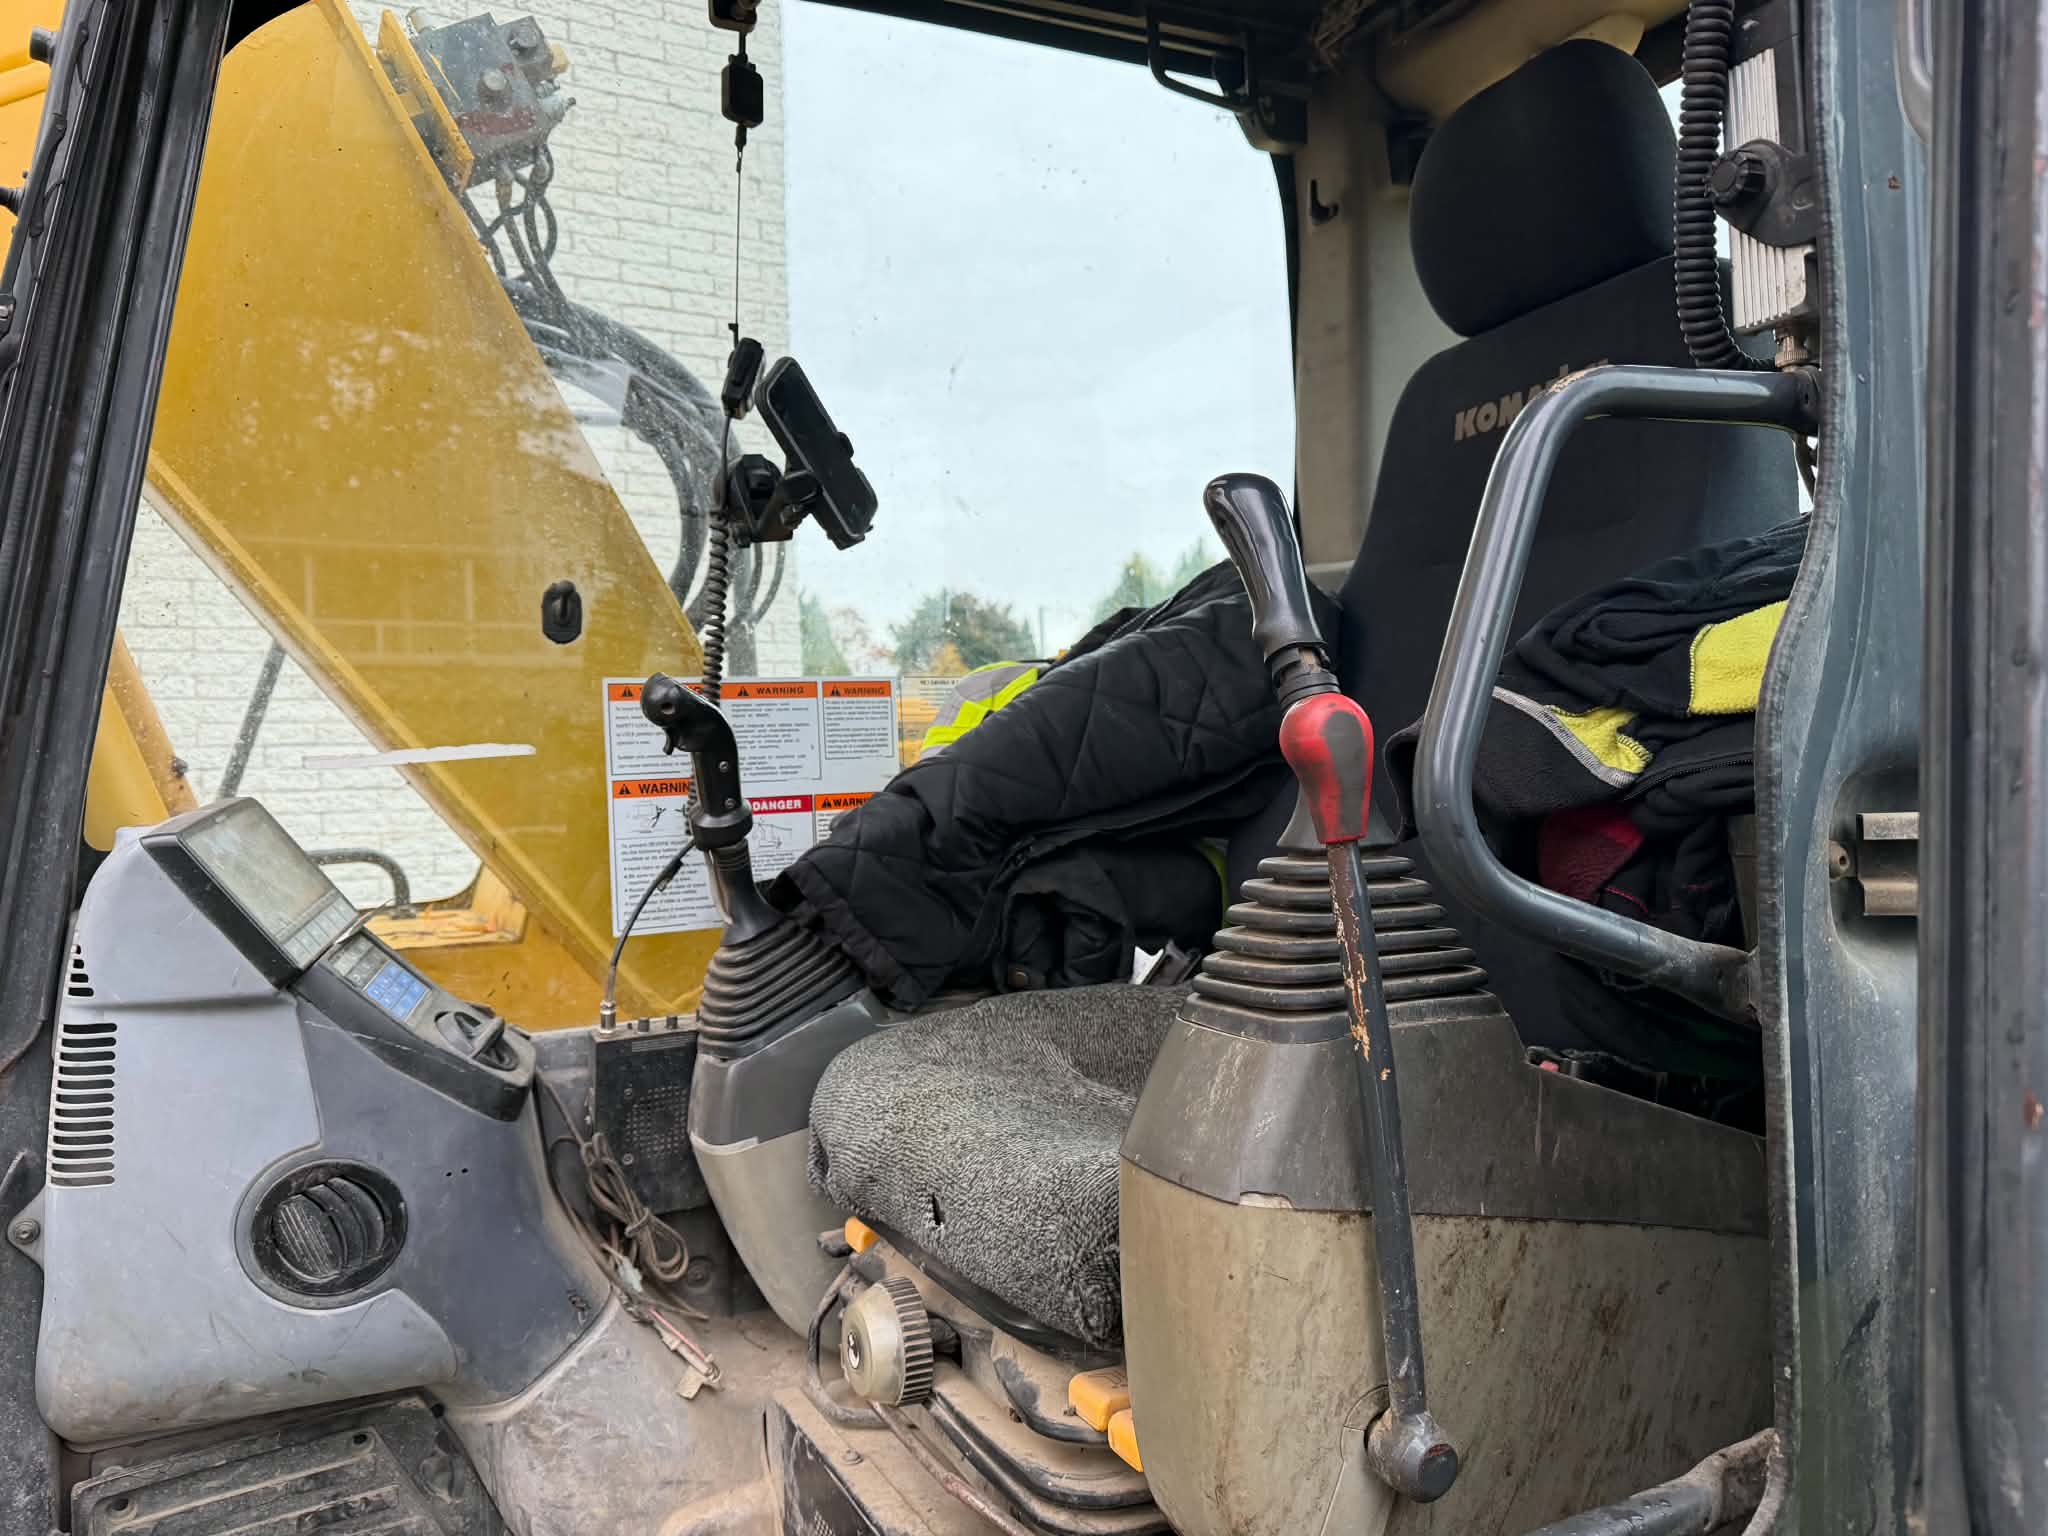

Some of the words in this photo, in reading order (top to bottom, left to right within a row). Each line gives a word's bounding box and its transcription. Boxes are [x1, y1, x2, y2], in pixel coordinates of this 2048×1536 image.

[756, 687, 804, 695] WARNING
[843, 687, 885, 695] WARNING
[639, 783, 689, 794] WARNIN
[752, 799, 802, 811] DANGER
[832, 798, 867, 808] WARN
